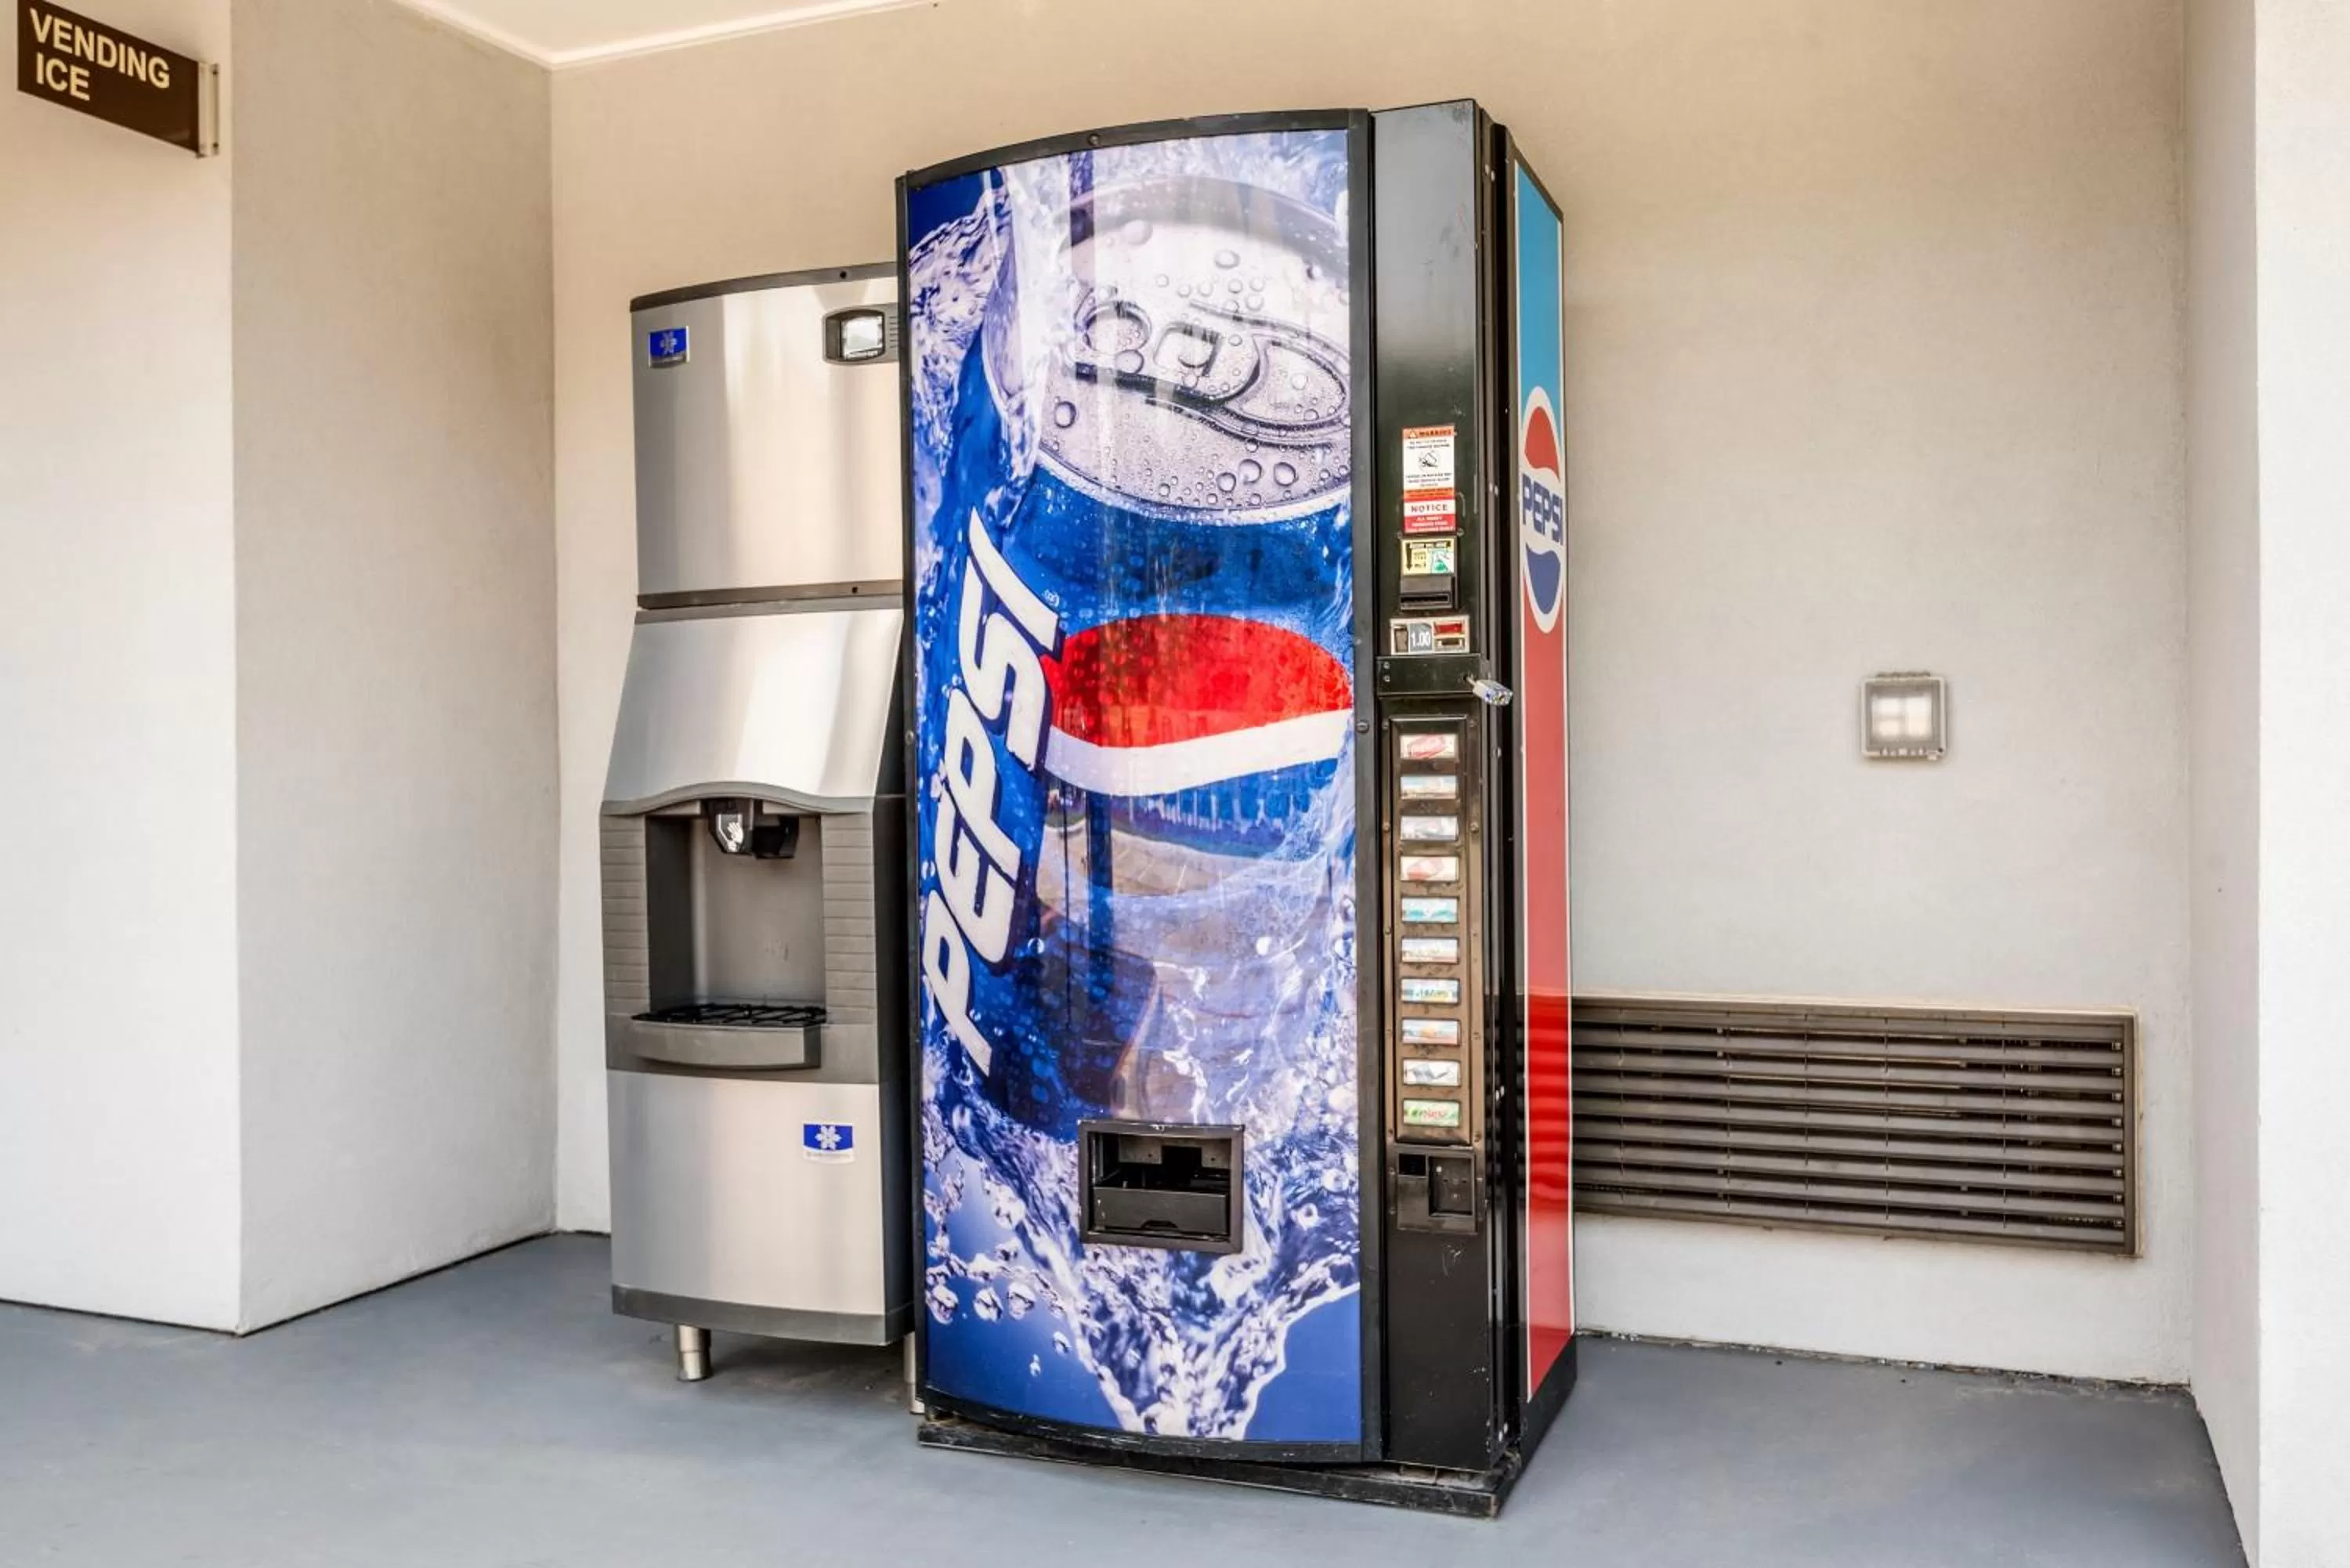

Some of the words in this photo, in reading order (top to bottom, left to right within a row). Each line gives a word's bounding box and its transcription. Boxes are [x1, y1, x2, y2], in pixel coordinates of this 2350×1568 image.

[30, 8, 170, 89] VENDING
[36, 52, 90, 101] ICE
[1411, 504, 1448, 513] NOTICE
[1521, 473, 1564, 546] PEPSI
[1411, 631, 1431, 648] 1.00
[923, 505, 1059, 1078] PEPSI
